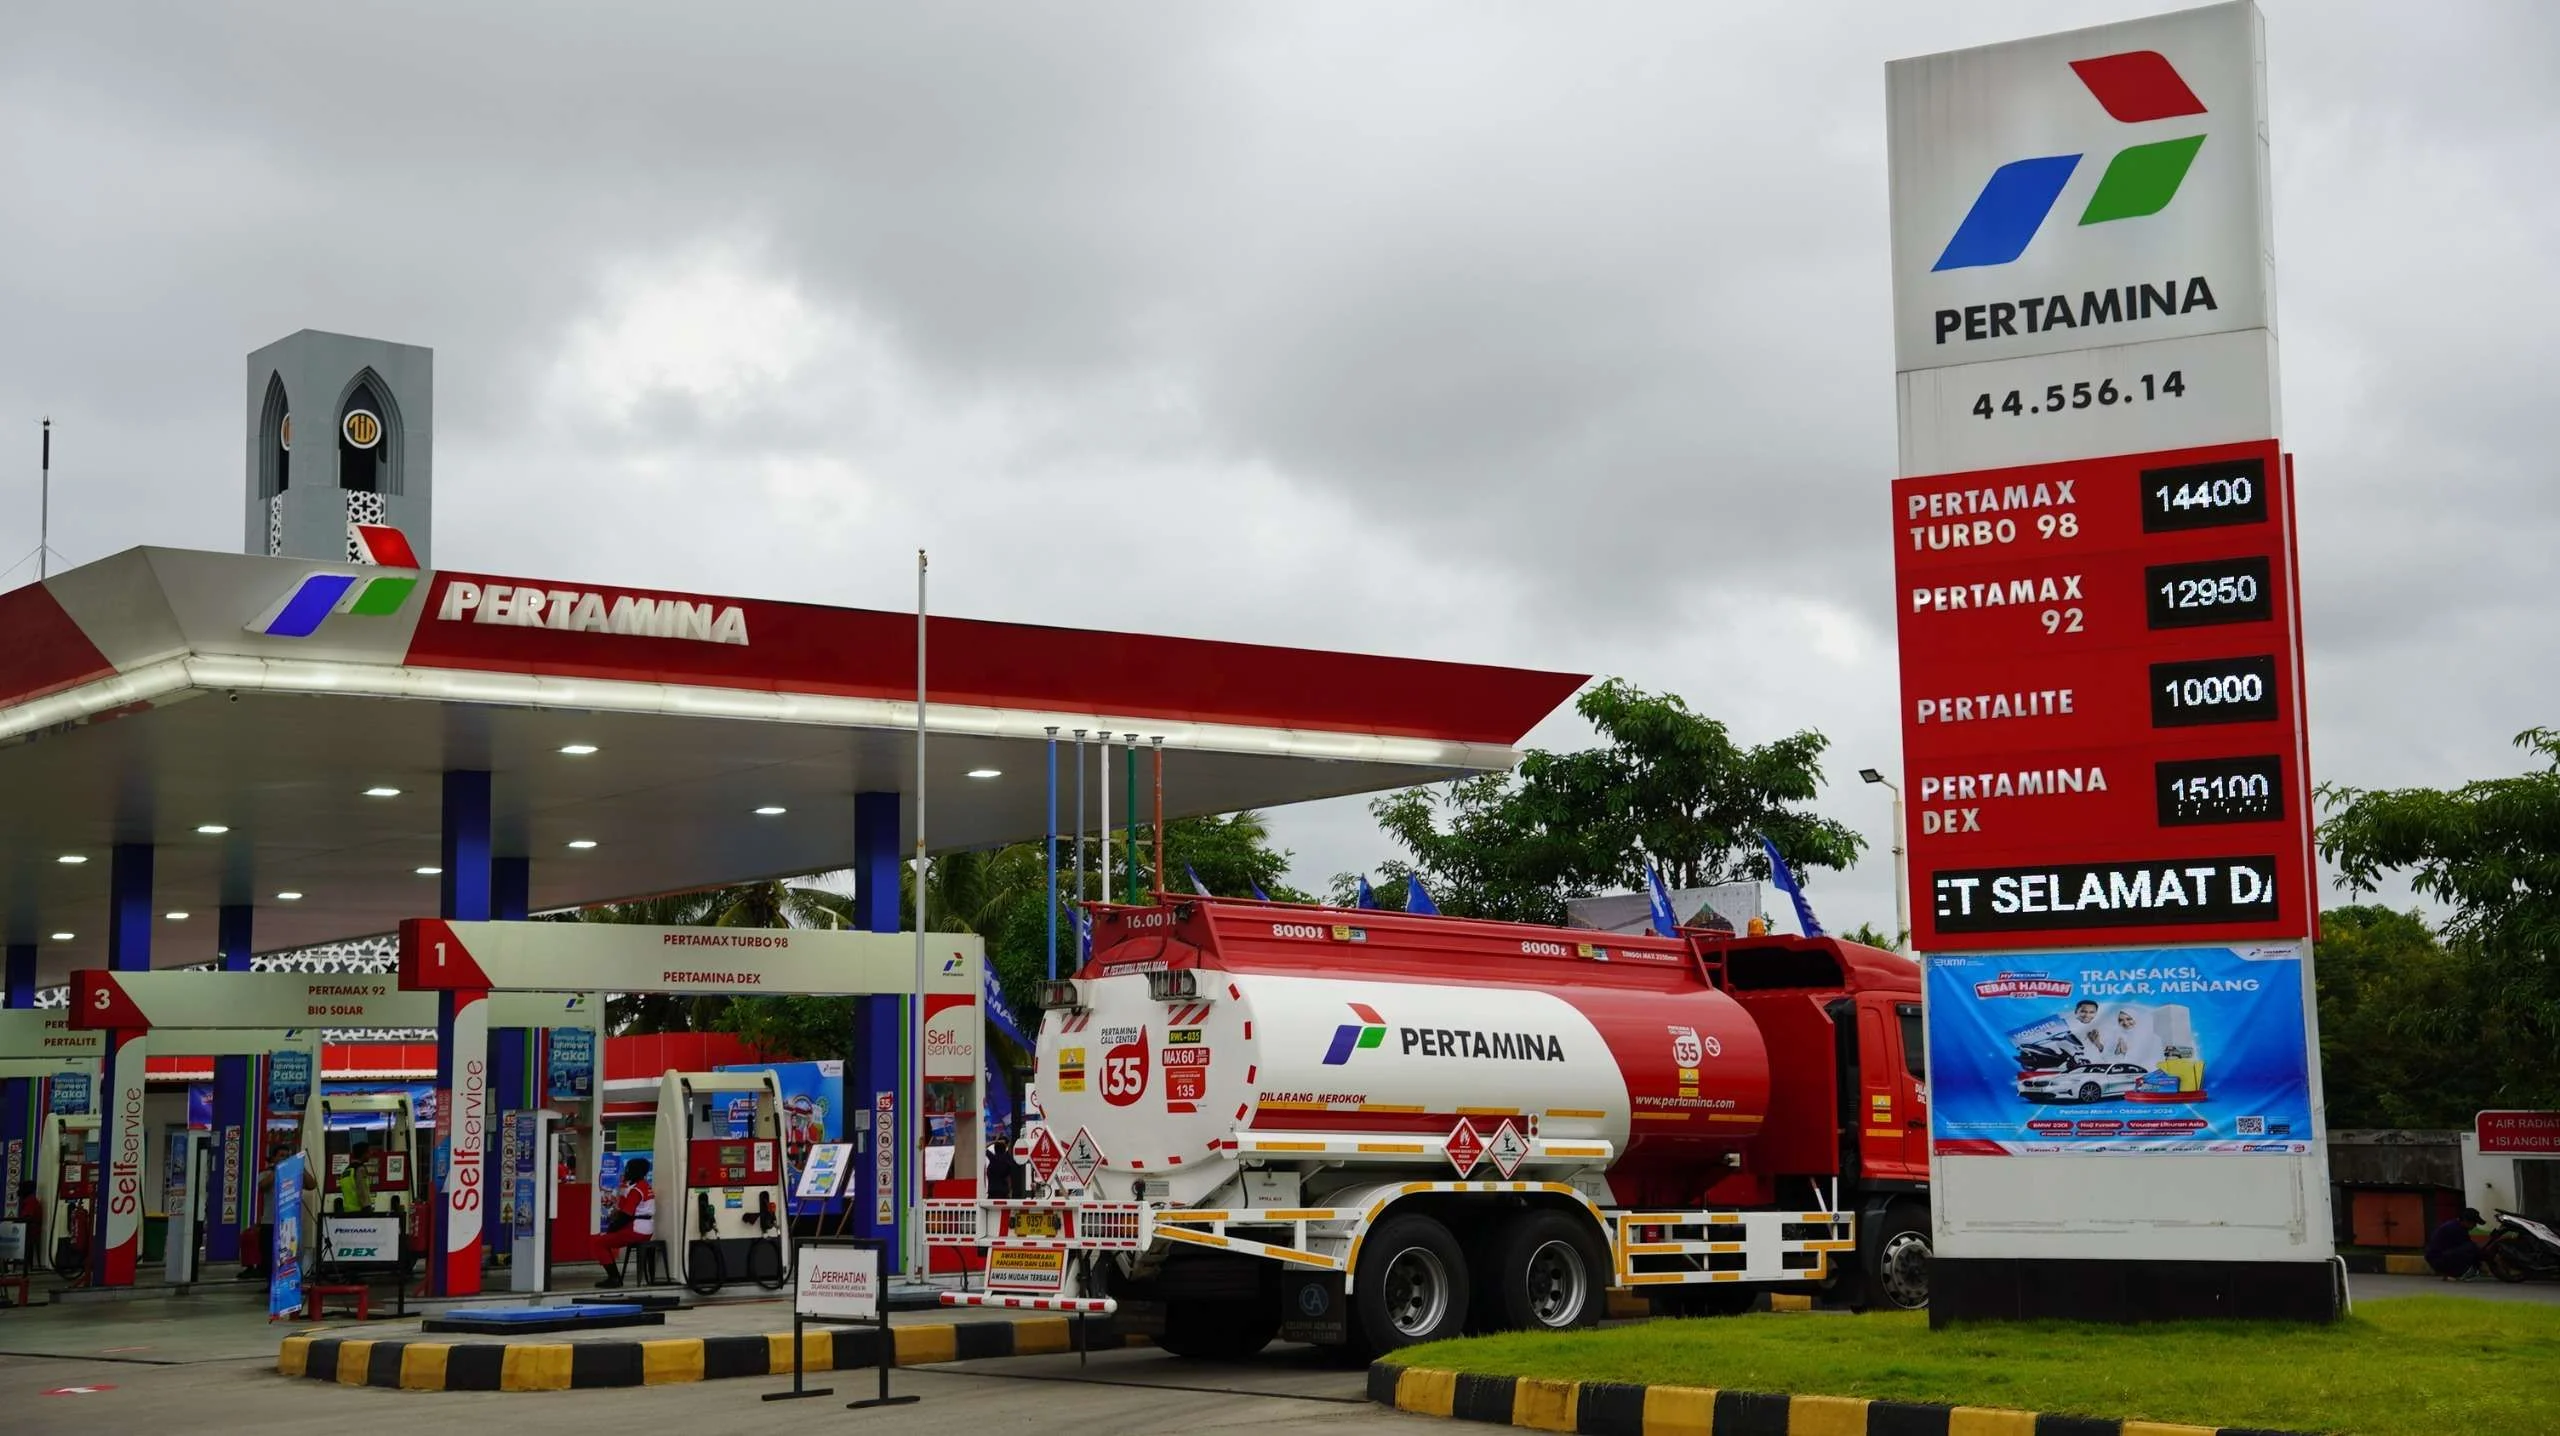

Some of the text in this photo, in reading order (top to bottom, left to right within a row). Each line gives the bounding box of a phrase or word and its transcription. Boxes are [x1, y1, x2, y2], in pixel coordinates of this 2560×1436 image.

[1935, 276, 2218, 344] PERTAMINA
[1972, 370, 2185, 420] 44.556.14
[1908, 480, 2076, 520] PERTAMAX
[2156, 476, 2252, 512] 14400
[1910, 513, 2079, 551] TURBO 98
[1913, 574, 2083, 613] PERTAMAX
[2161, 574, 2257, 609] 12950
[437, 581, 750, 646] PERTAMINA
[2040, 607, 2084, 635] 92
[2165, 673, 2262, 708] 10000
[1917, 689, 2074, 724] PERTALITE
[1921, 767, 2108, 802] PERTAMINA
[1922, 808, 1982, 835] DEX
[1991, 867, 2215, 915] SELAMAT
[663, 934, 789, 948] PERTAMAX TURBO 98
[435, 942, 446, 967] 1
[663, 971, 761, 984] PERTAMINA DEX
[2079, 967, 2201, 981] TRANSAKSI,
[308, 985, 386, 995] PERTAMAX 92
[1977, 981, 2072, 994] TEBAR HADIAH
[2080, 979, 2260, 995] TUKAR, MENANG
[94, 988, 111, 1010] 3
[308, 1006, 363, 1015] BIO SOLAR
[1101, 1026, 1138, 1036] PERTAMINA
[1101, 1034, 1137, 1045] CALL CENTER
[44, 1037, 97, 1047] PERTALITE
[927, 1044, 972, 1056] service
[1400, 1027, 1565, 1062] PERTAMINA
[1674, 1042, 1699, 1061] 135
[1101, 1057, 1142, 1097] 135
[1176, 1084, 1195, 1097] 135
[1259, 1092, 1367, 1104] DILARANG MEROKOK
[1635, 1095, 1735, 1109] www.pertamina.com
[2496, 1119, 2515, 1129] AIR
[2496, 1136, 2510, 1146] ISI
[2513, 1136, 2549, 1146] ANGIN
[337, 1247, 378, 1257] DEX
[821, 1271, 867, 1283] PERHATIAN
[991, 1272, 1058, 1282] AWAS MUDAH TERBAKAR
